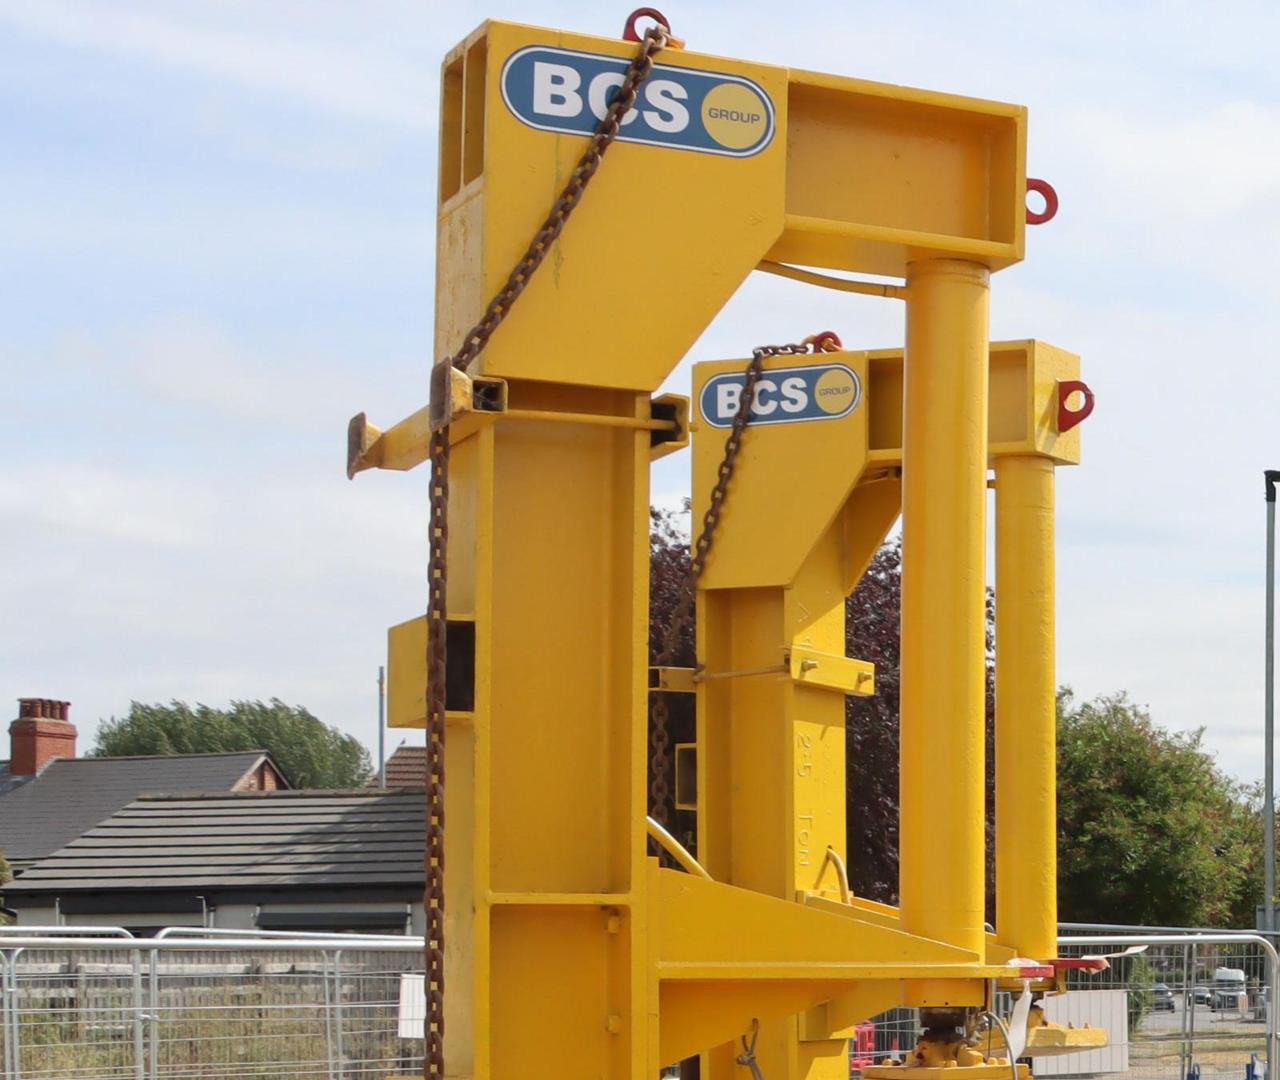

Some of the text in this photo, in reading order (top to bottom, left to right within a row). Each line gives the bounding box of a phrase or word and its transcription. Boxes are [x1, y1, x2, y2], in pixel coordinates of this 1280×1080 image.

[533, 61, 760, 133] BCS GROUP
[717, 377, 851, 418] BCS GROUP
